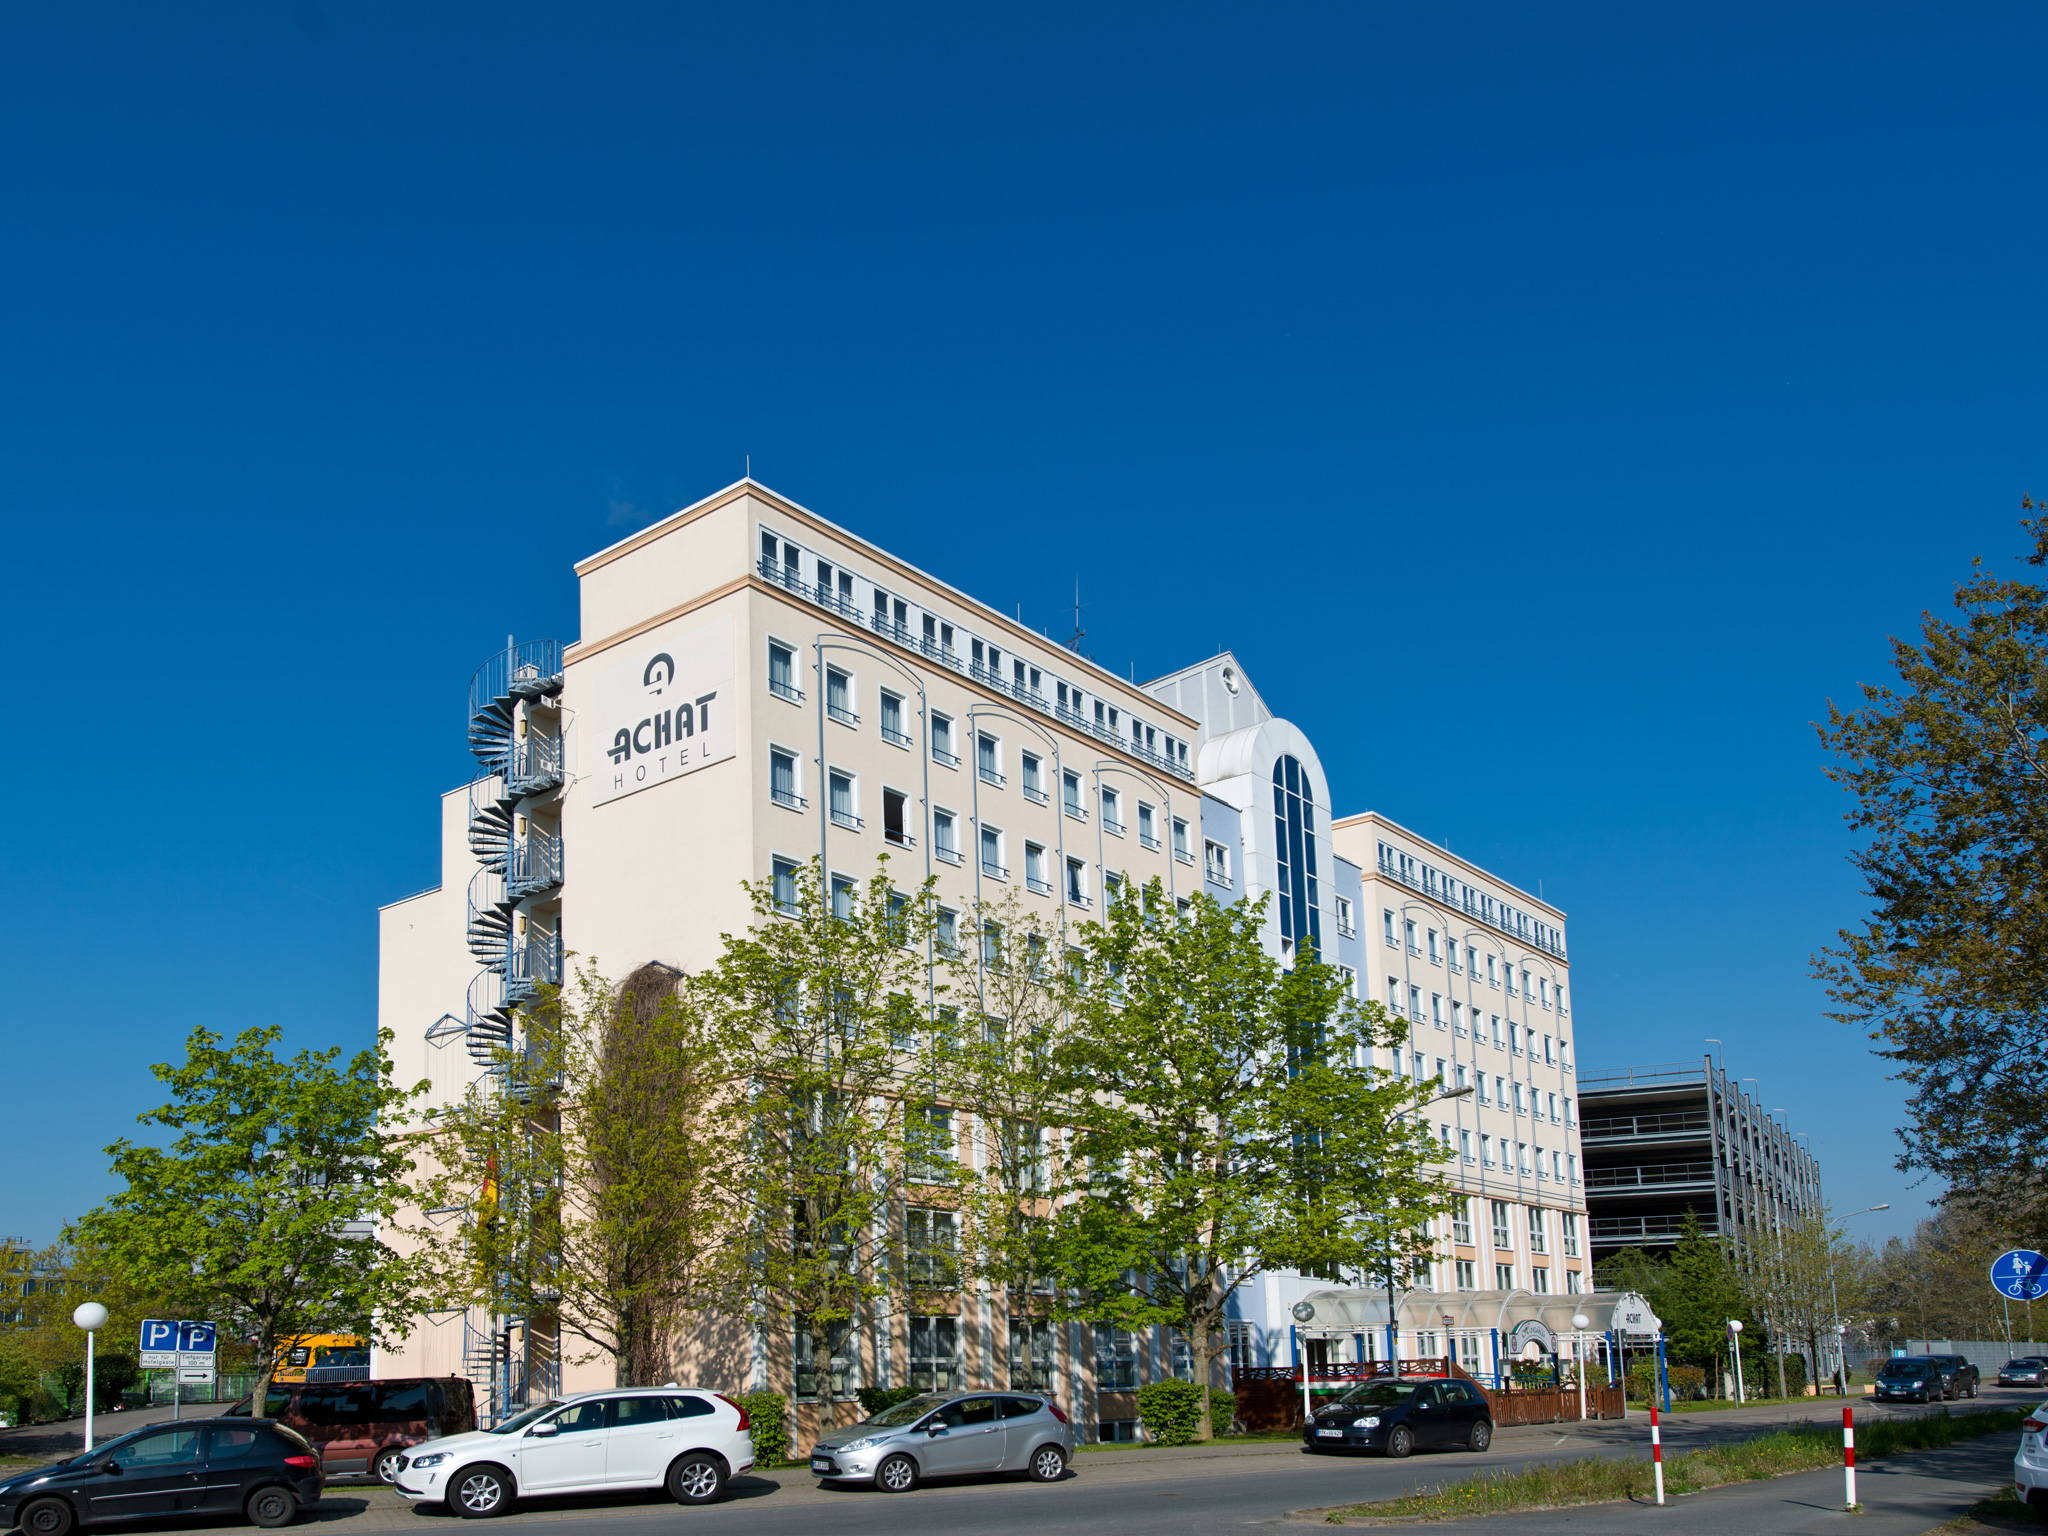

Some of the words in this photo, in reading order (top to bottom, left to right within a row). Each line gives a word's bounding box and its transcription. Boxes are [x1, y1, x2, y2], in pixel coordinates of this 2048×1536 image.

[606, 690, 718, 766] ACHAT
[614, 742, 711, 790] HOTEL
[149, 1323, 170, 1347] P
[188, 1329, 208, 1350] P
